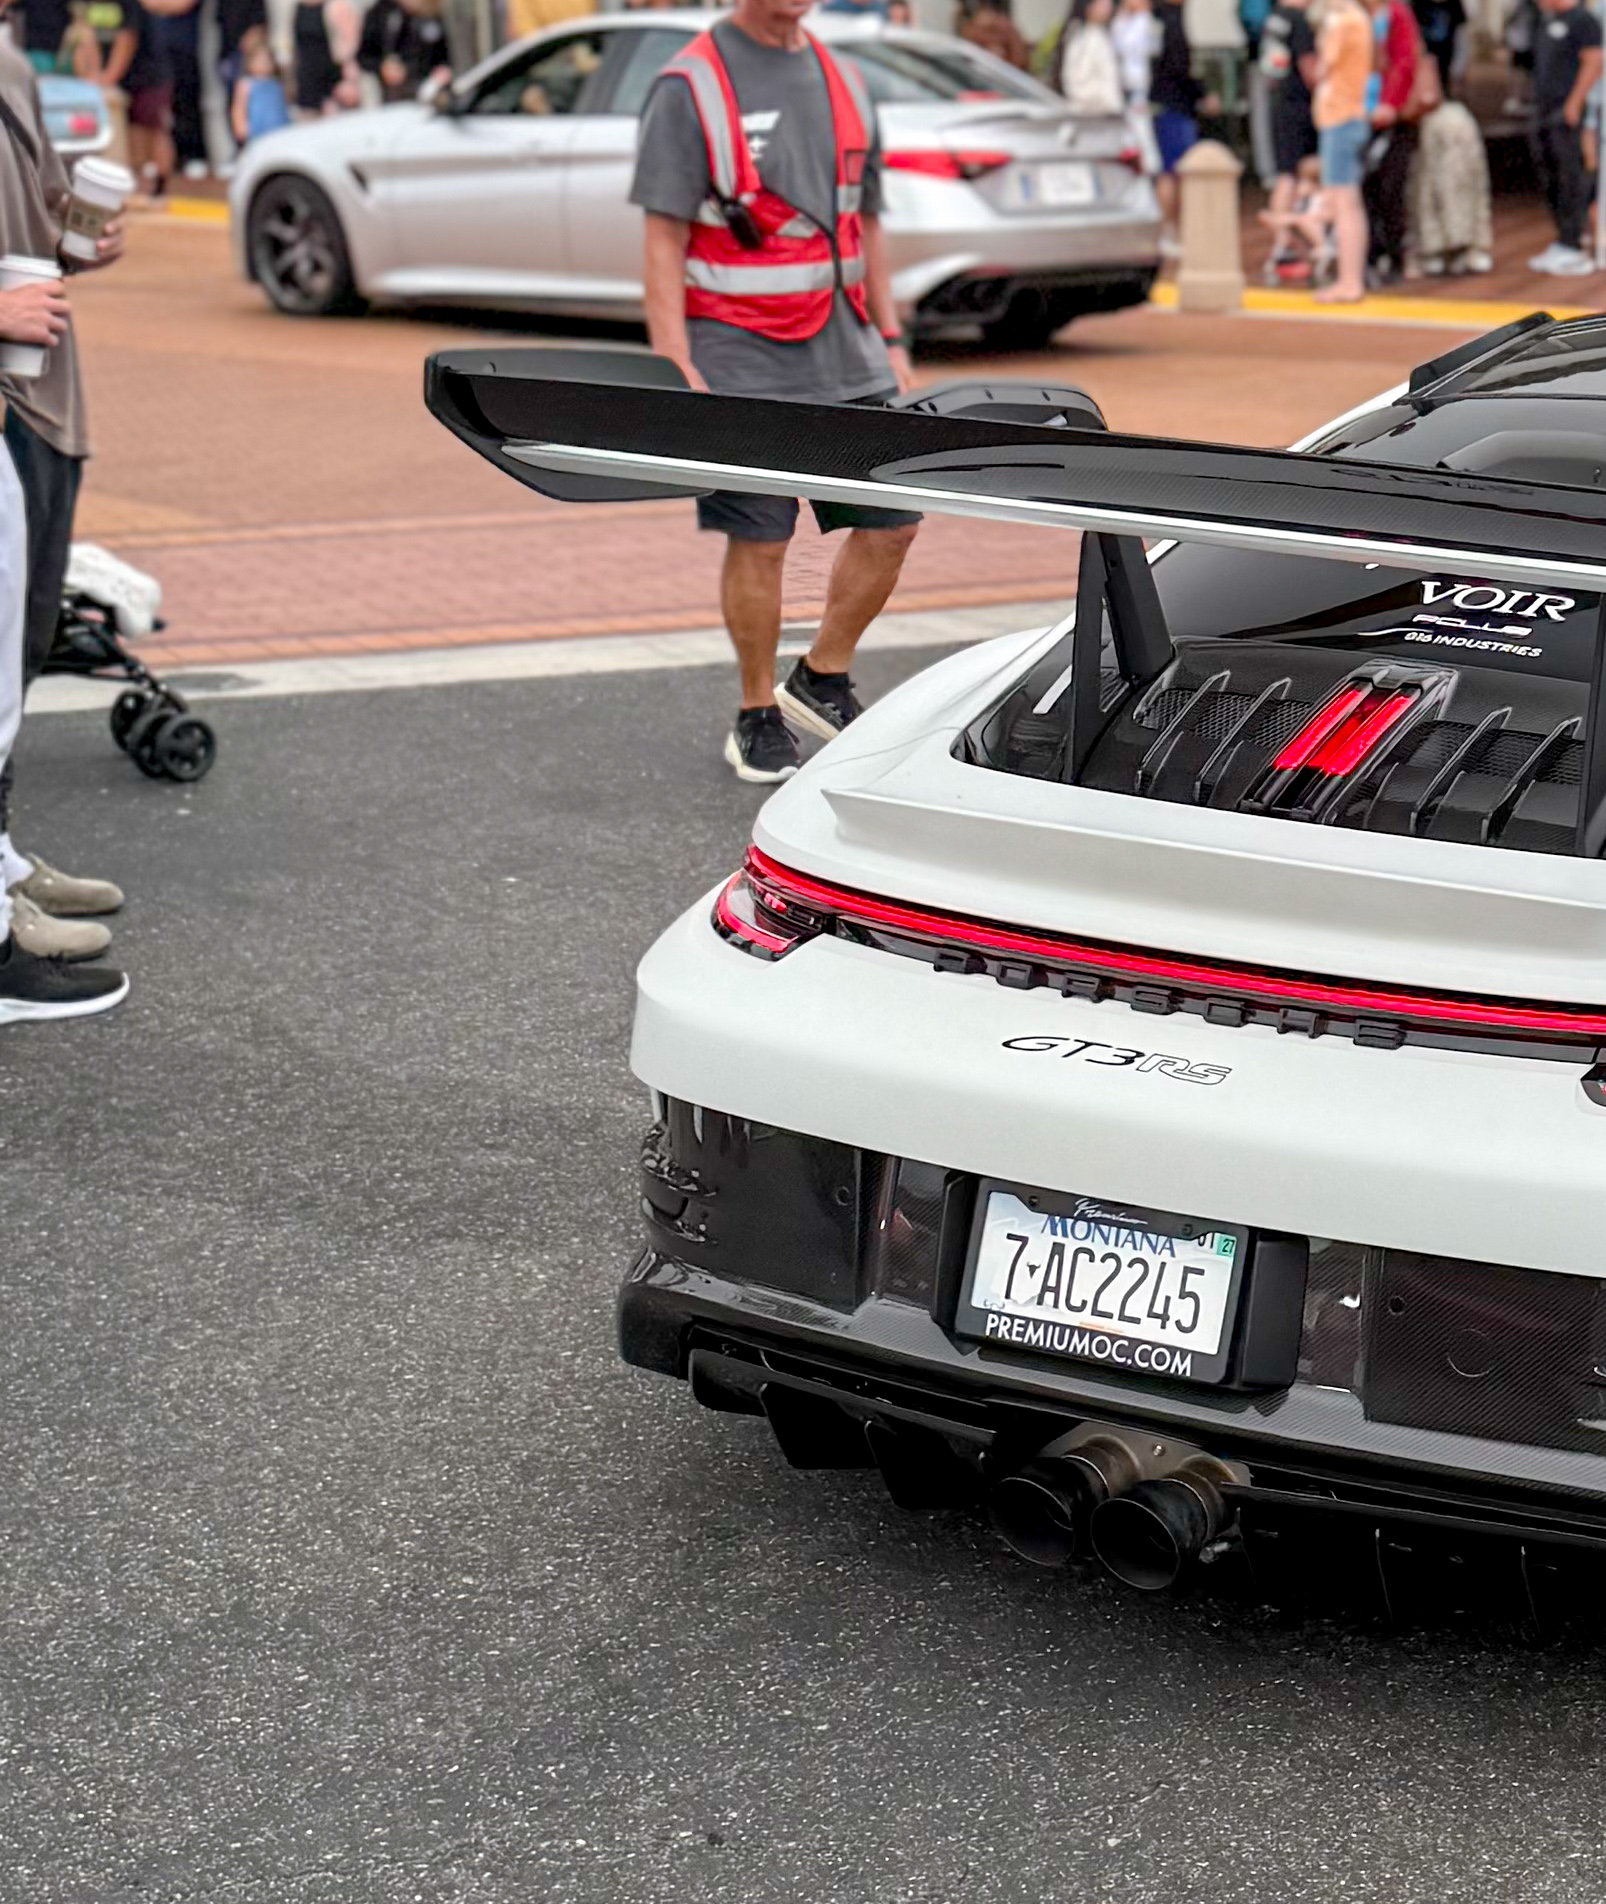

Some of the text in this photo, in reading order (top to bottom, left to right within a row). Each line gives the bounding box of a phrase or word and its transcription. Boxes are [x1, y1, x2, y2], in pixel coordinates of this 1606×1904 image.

[1421, 580, 1576, 623] VOIR
[1432, 635, 1543, 658] INDUSTRIES
[1041, 1213, 1176, 1258] MONTANA
[984, 1313, 1193, 1377] PREMIUMOC.COM
